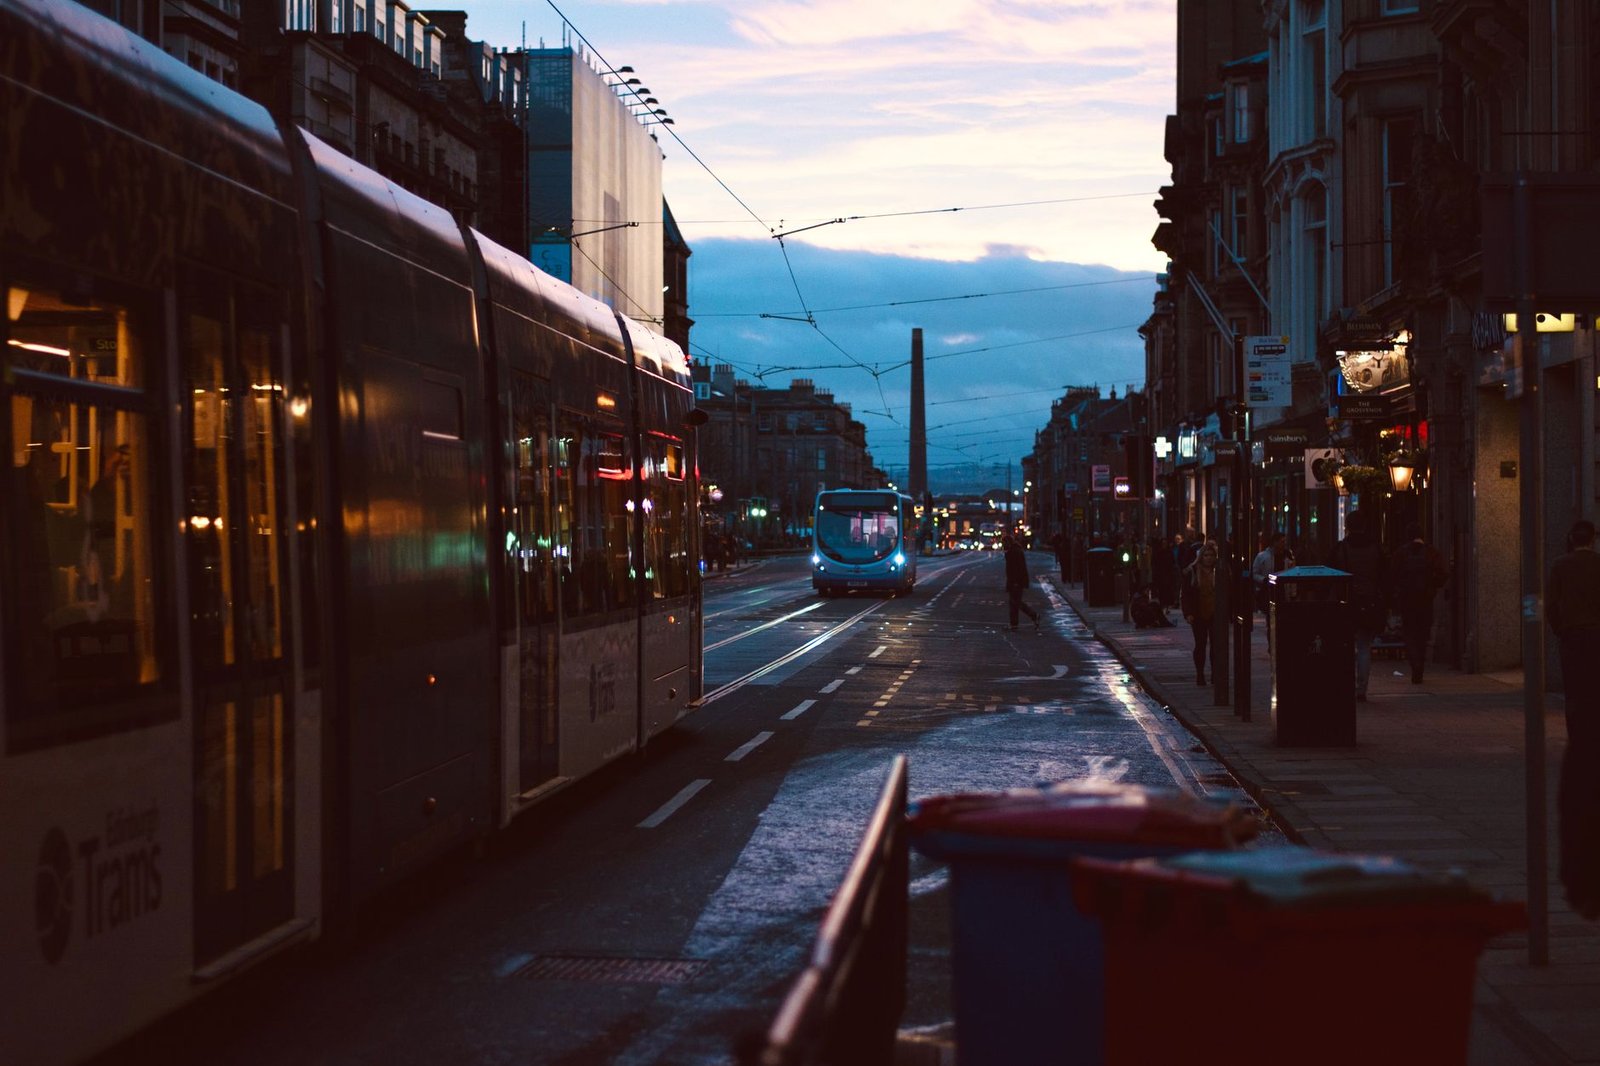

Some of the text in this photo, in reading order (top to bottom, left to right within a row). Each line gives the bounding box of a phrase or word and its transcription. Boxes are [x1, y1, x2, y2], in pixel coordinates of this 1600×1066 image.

[96, 338, 117, 350] Sto
[1268, 434, 1307, 445] Sainsbury's
[1216, 448, 1236, 456] Sainsb
[78, 836, 162, 939] Trams
